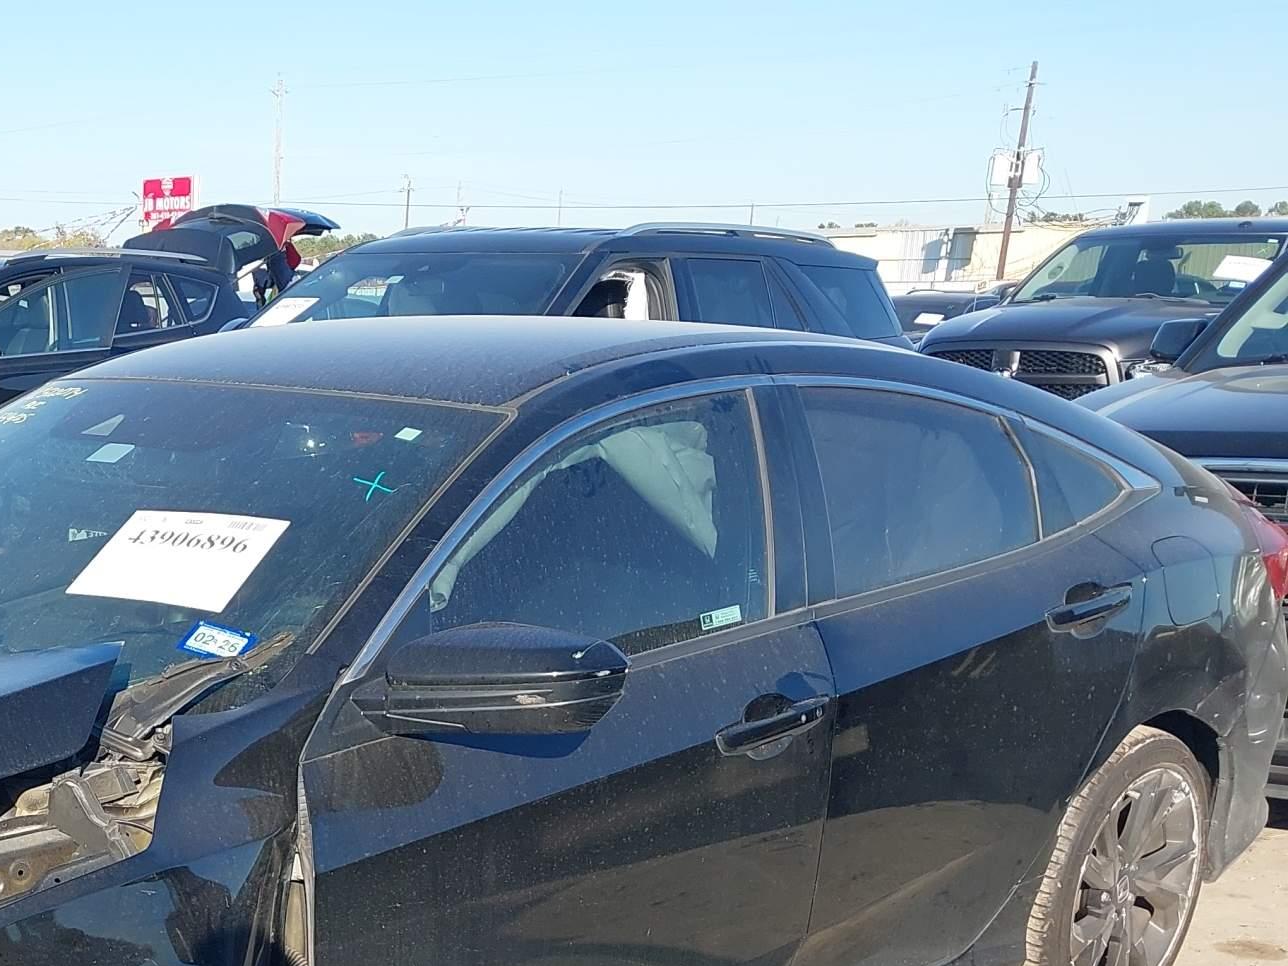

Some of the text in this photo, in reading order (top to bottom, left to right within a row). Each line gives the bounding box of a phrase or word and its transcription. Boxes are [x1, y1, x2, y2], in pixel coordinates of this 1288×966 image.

[155, 195, 192, 210] MOTORS
[128, 529, 248, 553] 43906896
[194, 632, 240, 653] 02 26
